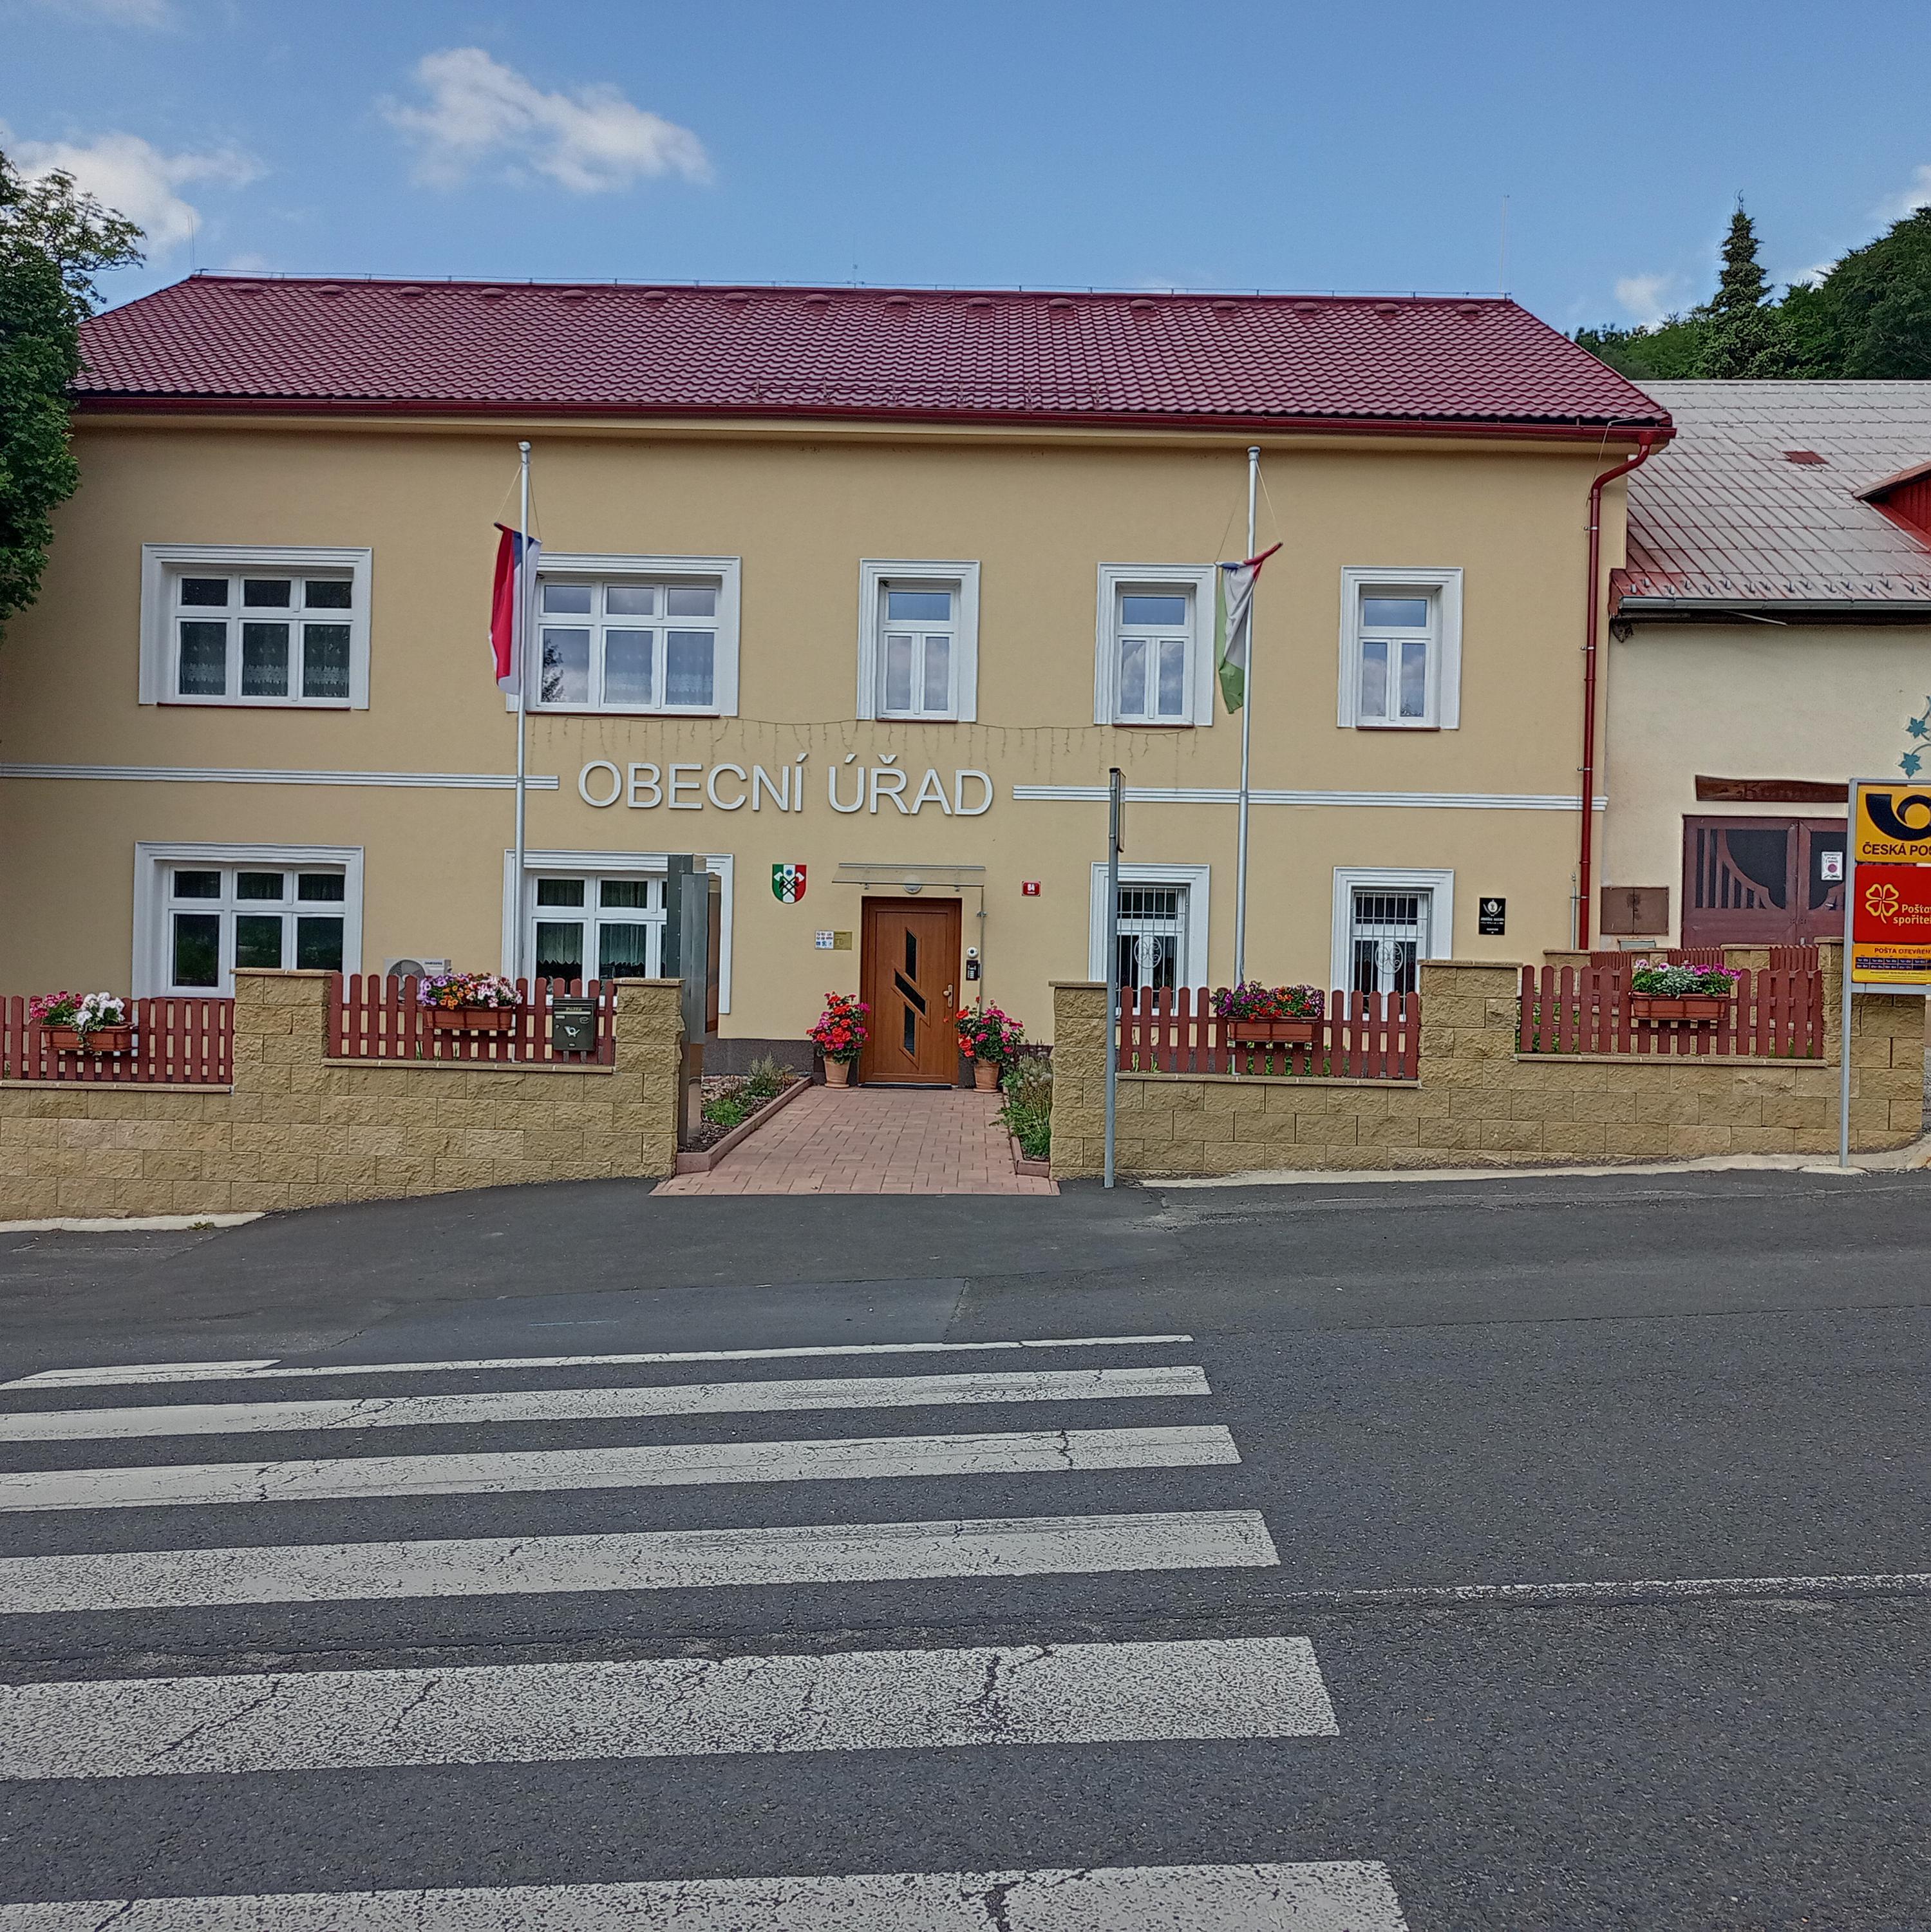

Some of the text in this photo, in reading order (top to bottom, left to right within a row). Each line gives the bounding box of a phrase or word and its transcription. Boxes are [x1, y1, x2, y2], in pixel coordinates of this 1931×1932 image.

[578, 752, 994, 816] OBECNÍ ÚŘAD
[1863, 842, 1931, 856] ČESKÁ PO
